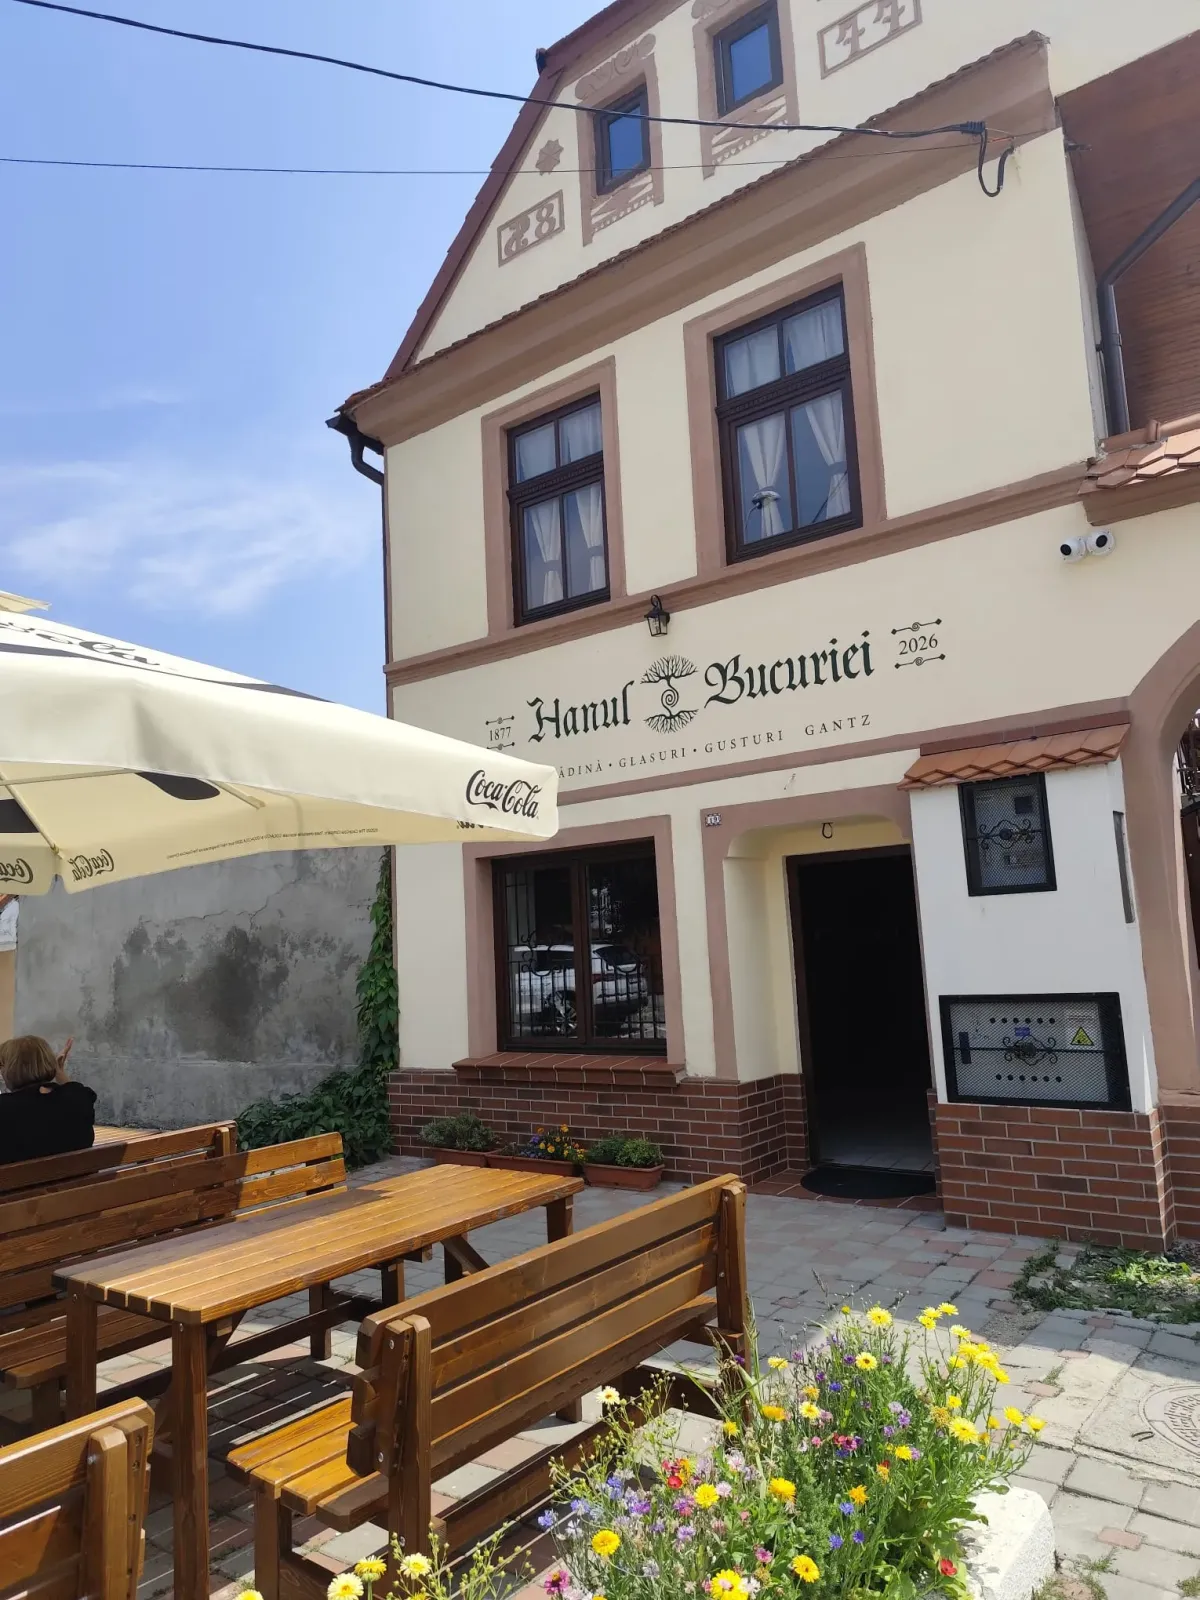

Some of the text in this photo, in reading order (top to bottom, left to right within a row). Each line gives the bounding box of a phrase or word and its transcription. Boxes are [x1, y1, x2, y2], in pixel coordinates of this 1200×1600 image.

[898, 634, 938, 656] 2026
[526, 629, 876, 743] Hanul Bucuriei
[488, 726, 513, 742] 1877
[618, 747, 687, 769] GLASURI
[704, 730, 785, 754] GUSTURI
[804, 714, 872, 736] GANTZ
[465, 769, 542, 819] Coca-Cola
